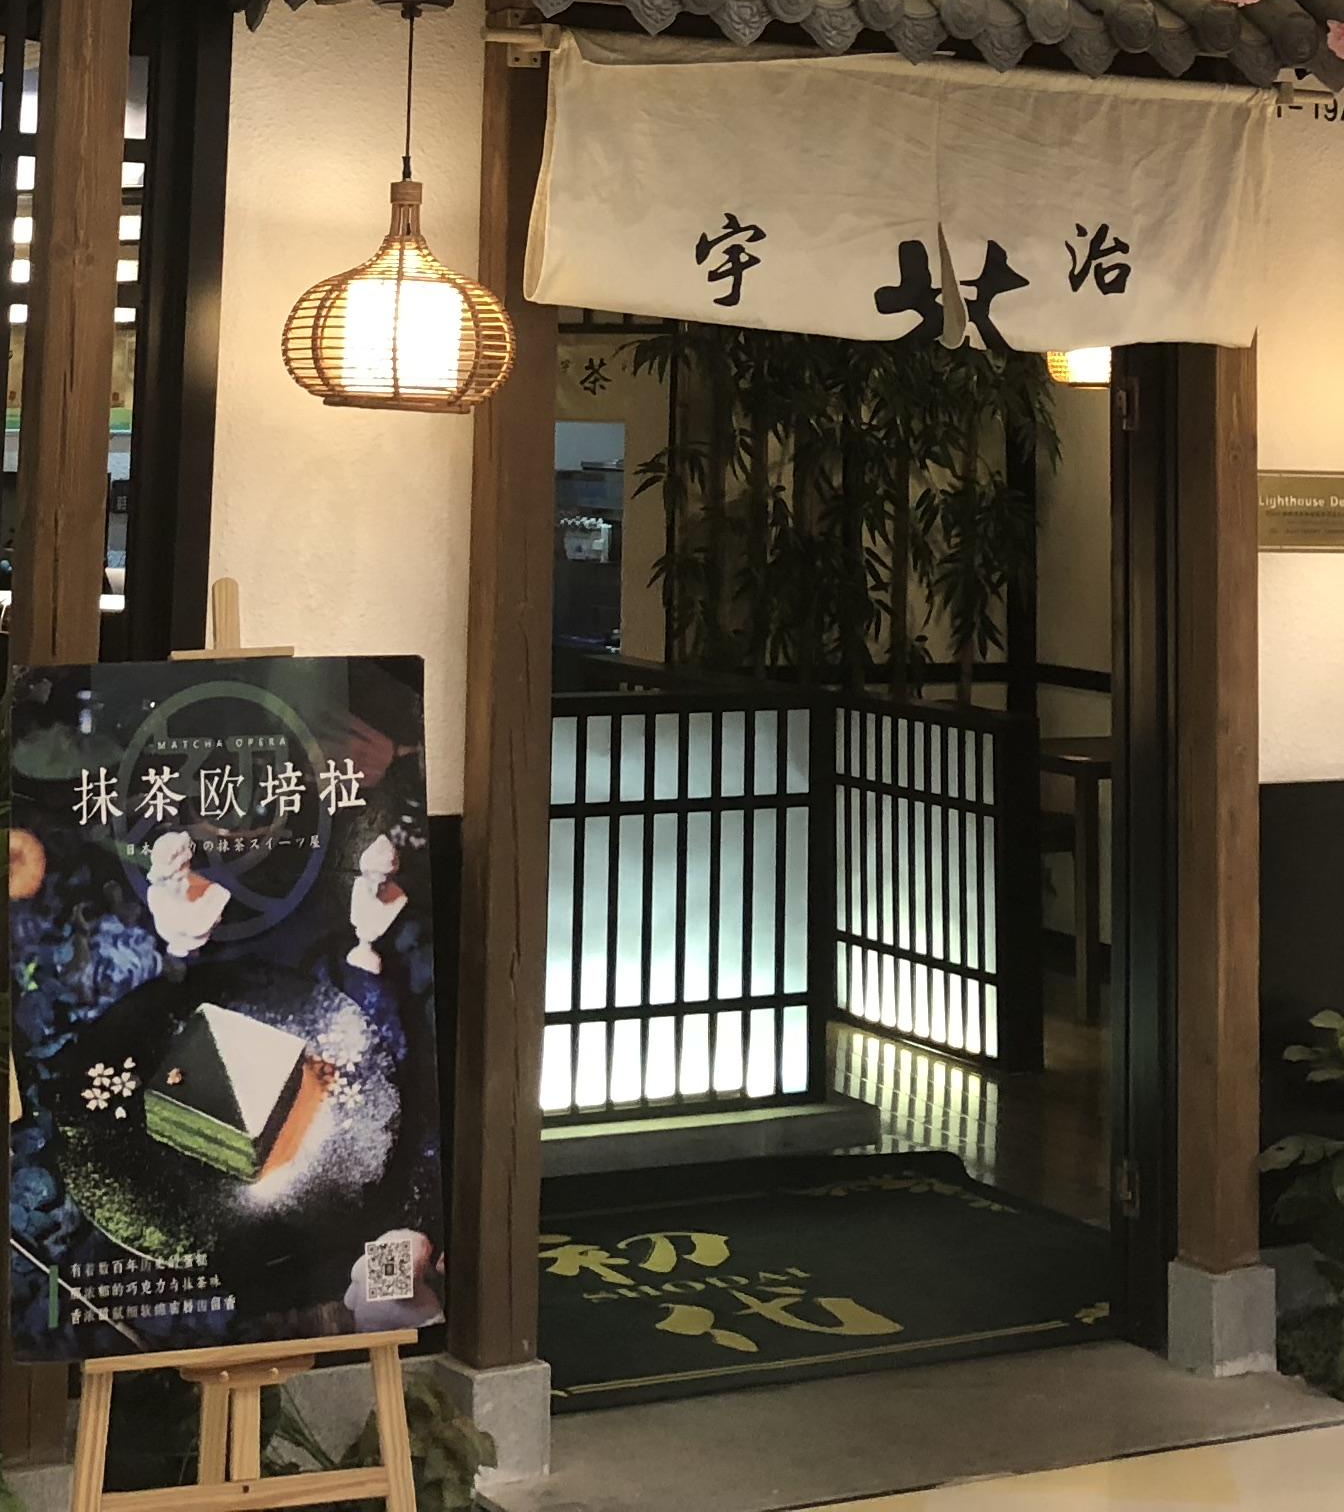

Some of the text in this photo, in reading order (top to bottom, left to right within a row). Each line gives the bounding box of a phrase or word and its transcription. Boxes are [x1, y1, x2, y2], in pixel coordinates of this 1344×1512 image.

[1258, 495, 1325, 509] Lighthouse
[157, 737, 287, 750] MATCHA OPERA
[72, 758, 367, 826] 抹茶欧培拉
